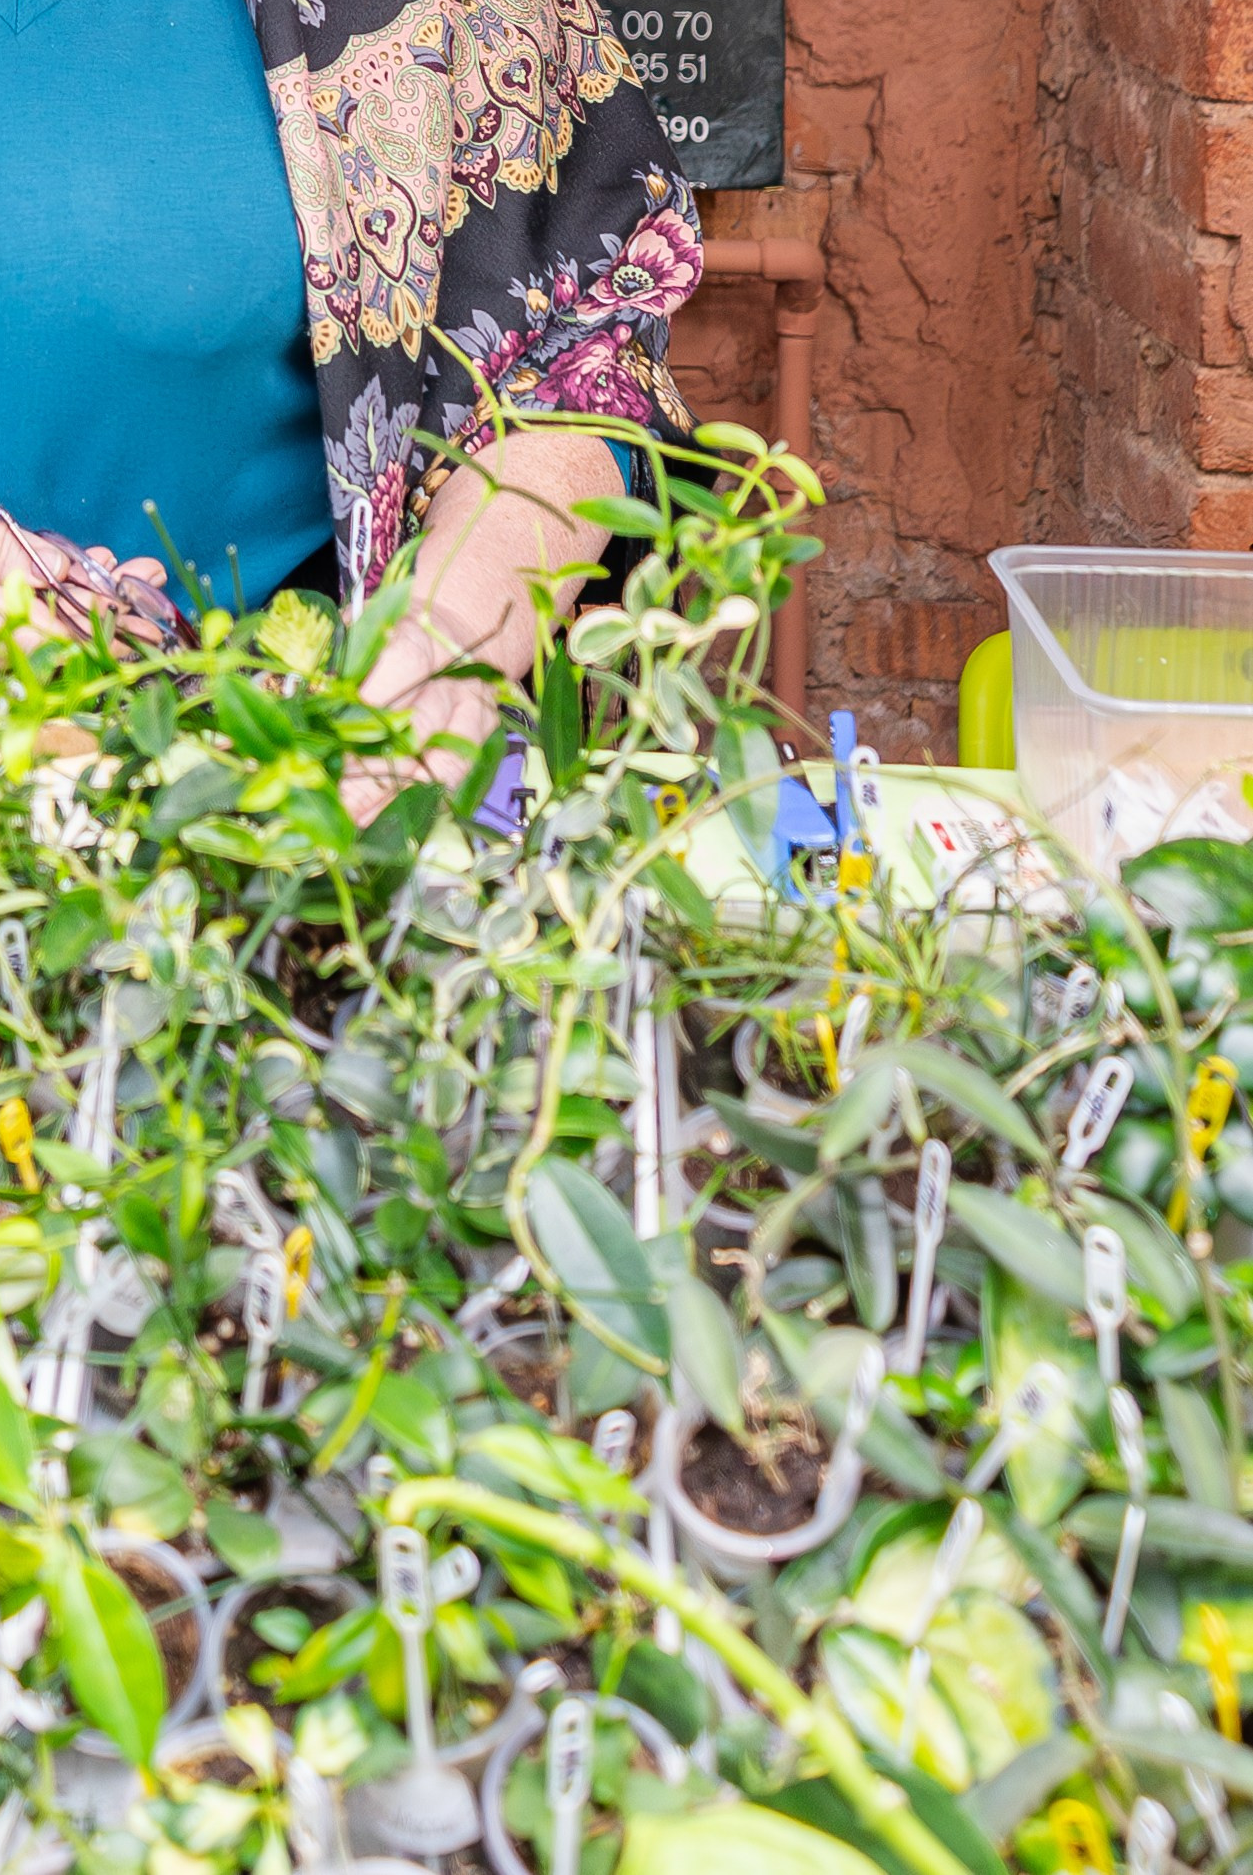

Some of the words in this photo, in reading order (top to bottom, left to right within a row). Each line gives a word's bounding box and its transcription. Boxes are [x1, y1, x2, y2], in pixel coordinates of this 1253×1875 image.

[621, 10, 664, 41] 00
[672, 10, 713, 41] 70
[631, 52, 669, 83] 85
[677, 53, 707, 84] 51
